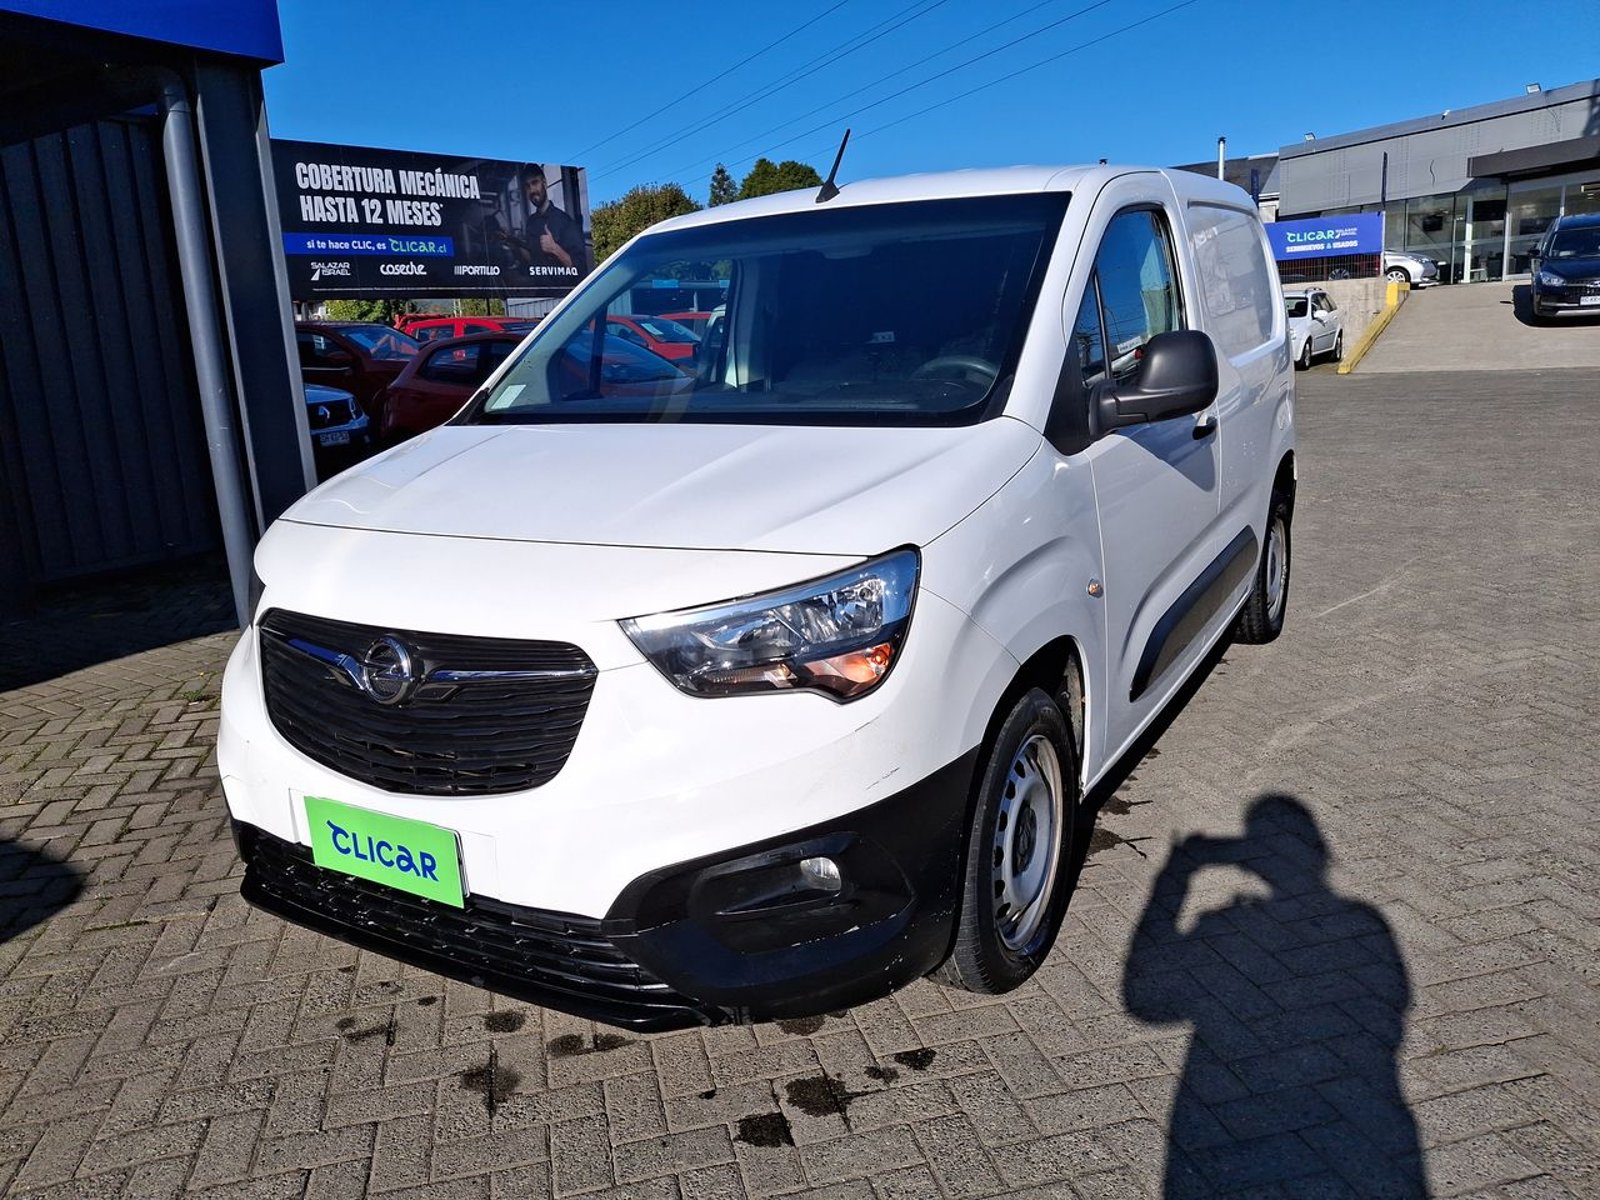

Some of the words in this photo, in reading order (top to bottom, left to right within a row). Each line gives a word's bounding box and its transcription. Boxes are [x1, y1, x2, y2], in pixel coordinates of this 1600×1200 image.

[295, 162, 397, 194] COBERTURA
[399, 167, 481, 199] MECÁNICA
[300, 195, 359, 223] HASTA
[361, 198, 384, 224] 12
[306, 239, 315, 249] si
[316, 240, 326, 249] te
[328, 239, 350, 249] hace
[351, 240, 375, 251] CLIC,
[310, 262, 350, 270] SALAZAR
[529, 266, 578, 276] SERVIMAQ
[321, 268, 351, 276] ISRAEL
